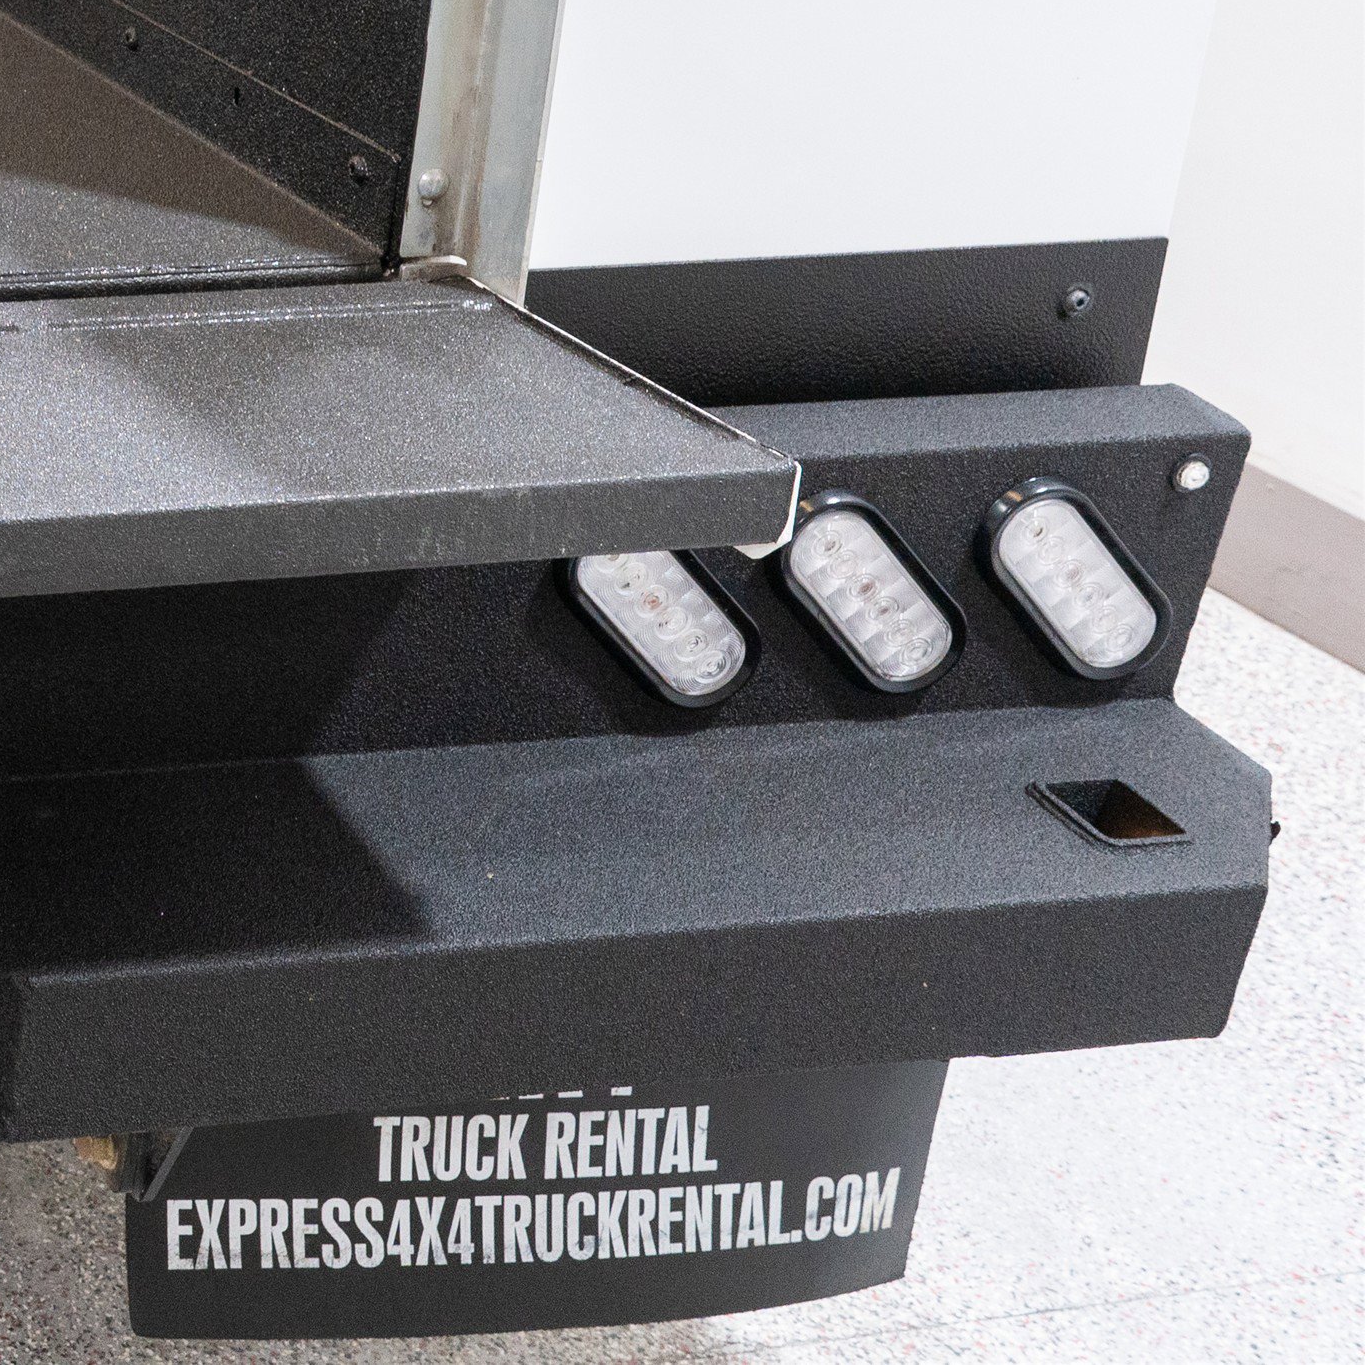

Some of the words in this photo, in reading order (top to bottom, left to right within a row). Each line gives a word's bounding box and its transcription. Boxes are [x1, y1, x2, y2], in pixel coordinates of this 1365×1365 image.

[373, 1113, 528, 1183] TRUCK
[544, 1105, 719, 1181] RENTAL
[165, 1167, 901, 1271] EXPRESS4X4TRUCKRENTAL.COM
